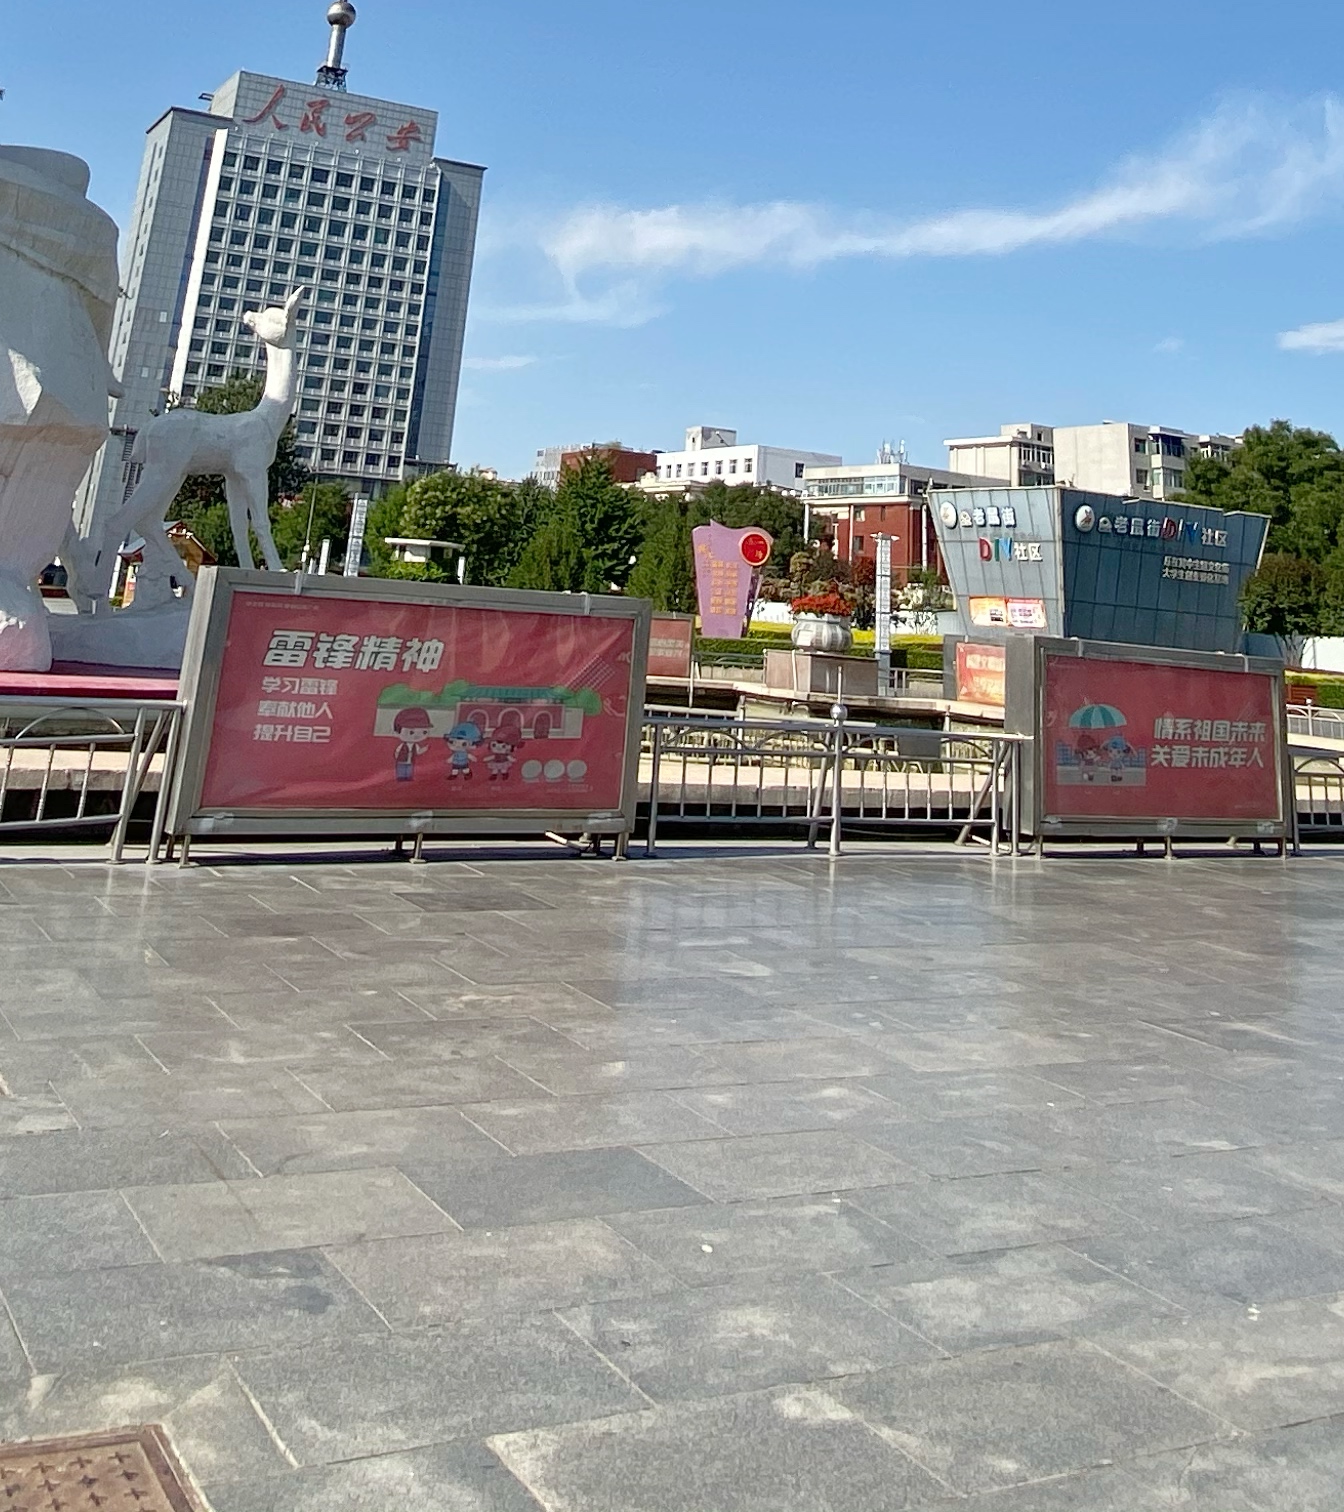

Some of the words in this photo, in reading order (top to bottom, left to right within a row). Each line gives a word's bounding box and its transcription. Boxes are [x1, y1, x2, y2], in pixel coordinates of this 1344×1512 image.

[241, 83, 424, 152] 人民公安
[263, 628, 445, 673] 雷锋精神
[261, 675, 338, 695] 学习雷锋
[257, 700, 334, 719] 奉献他人
[253, 724, 332, 743] 提升自己
[1154, 717, 1267, 742] 情系祖国未来
[1150, 744, 1265, 769] 关爱未成年人
